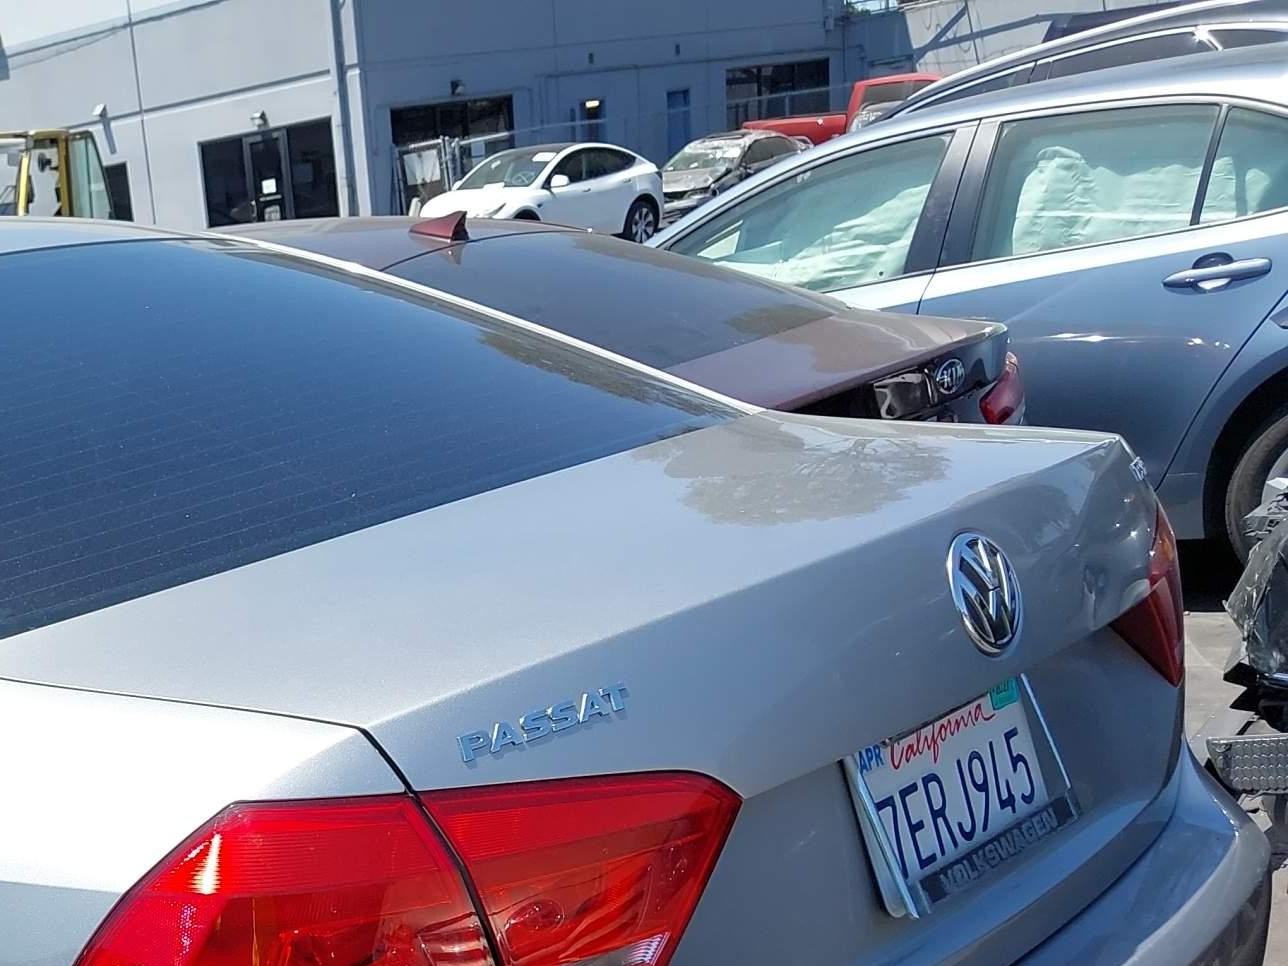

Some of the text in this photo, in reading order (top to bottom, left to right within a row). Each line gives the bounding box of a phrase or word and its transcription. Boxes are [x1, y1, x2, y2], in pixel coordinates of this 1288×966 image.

[456, 681, 628, 763] PASSAT
[858, 743, 885, 774] APR
[889, 702, 996, 771] California
[874, 726, 1036, 881] 7ERJ945
[939, 807, 1059, 891] VOLKSWAGEN
